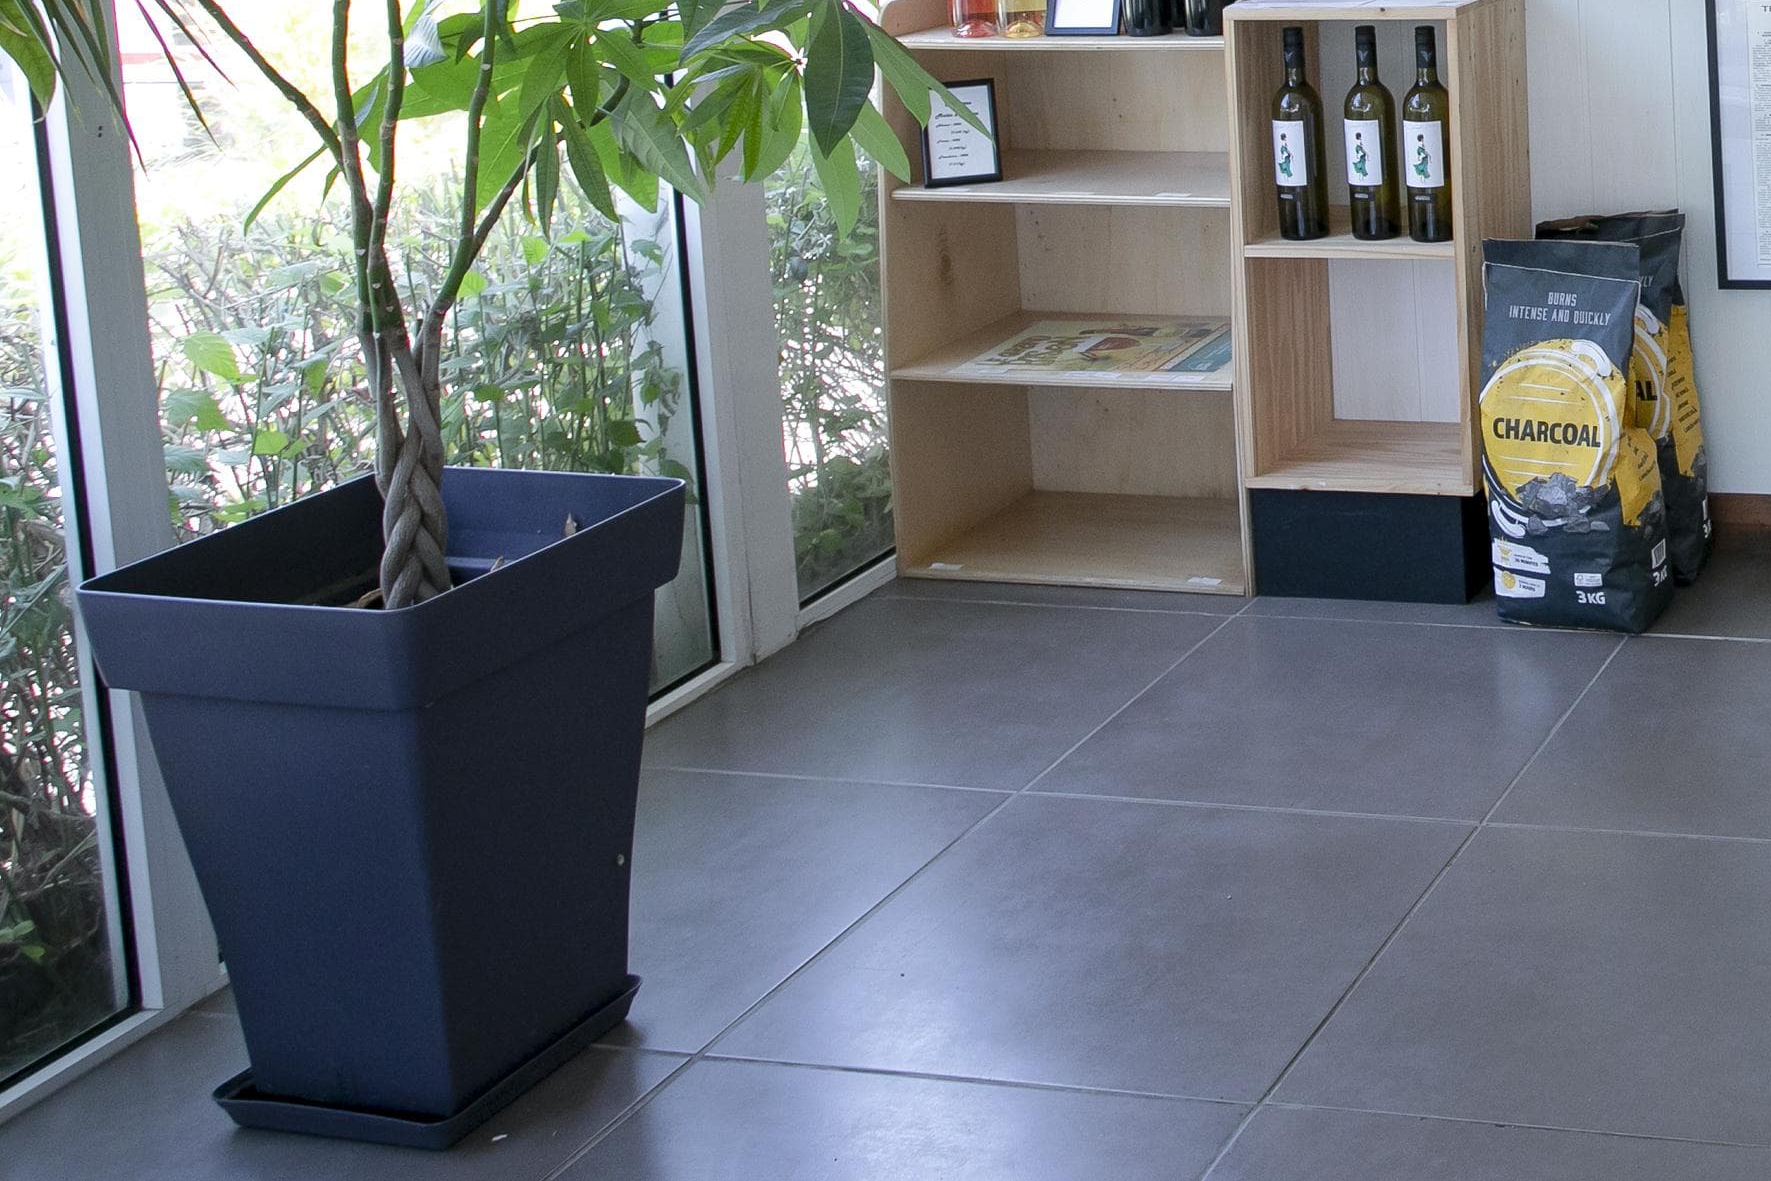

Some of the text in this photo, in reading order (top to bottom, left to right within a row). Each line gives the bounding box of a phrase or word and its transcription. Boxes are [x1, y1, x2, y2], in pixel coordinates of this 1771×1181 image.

[1547, 291, 1578, 307] BURNS
[1508, 305, 1612, 326] INTENSE AND QUICKLY
[1493, 417, 1602, 448] CHARCOAL
